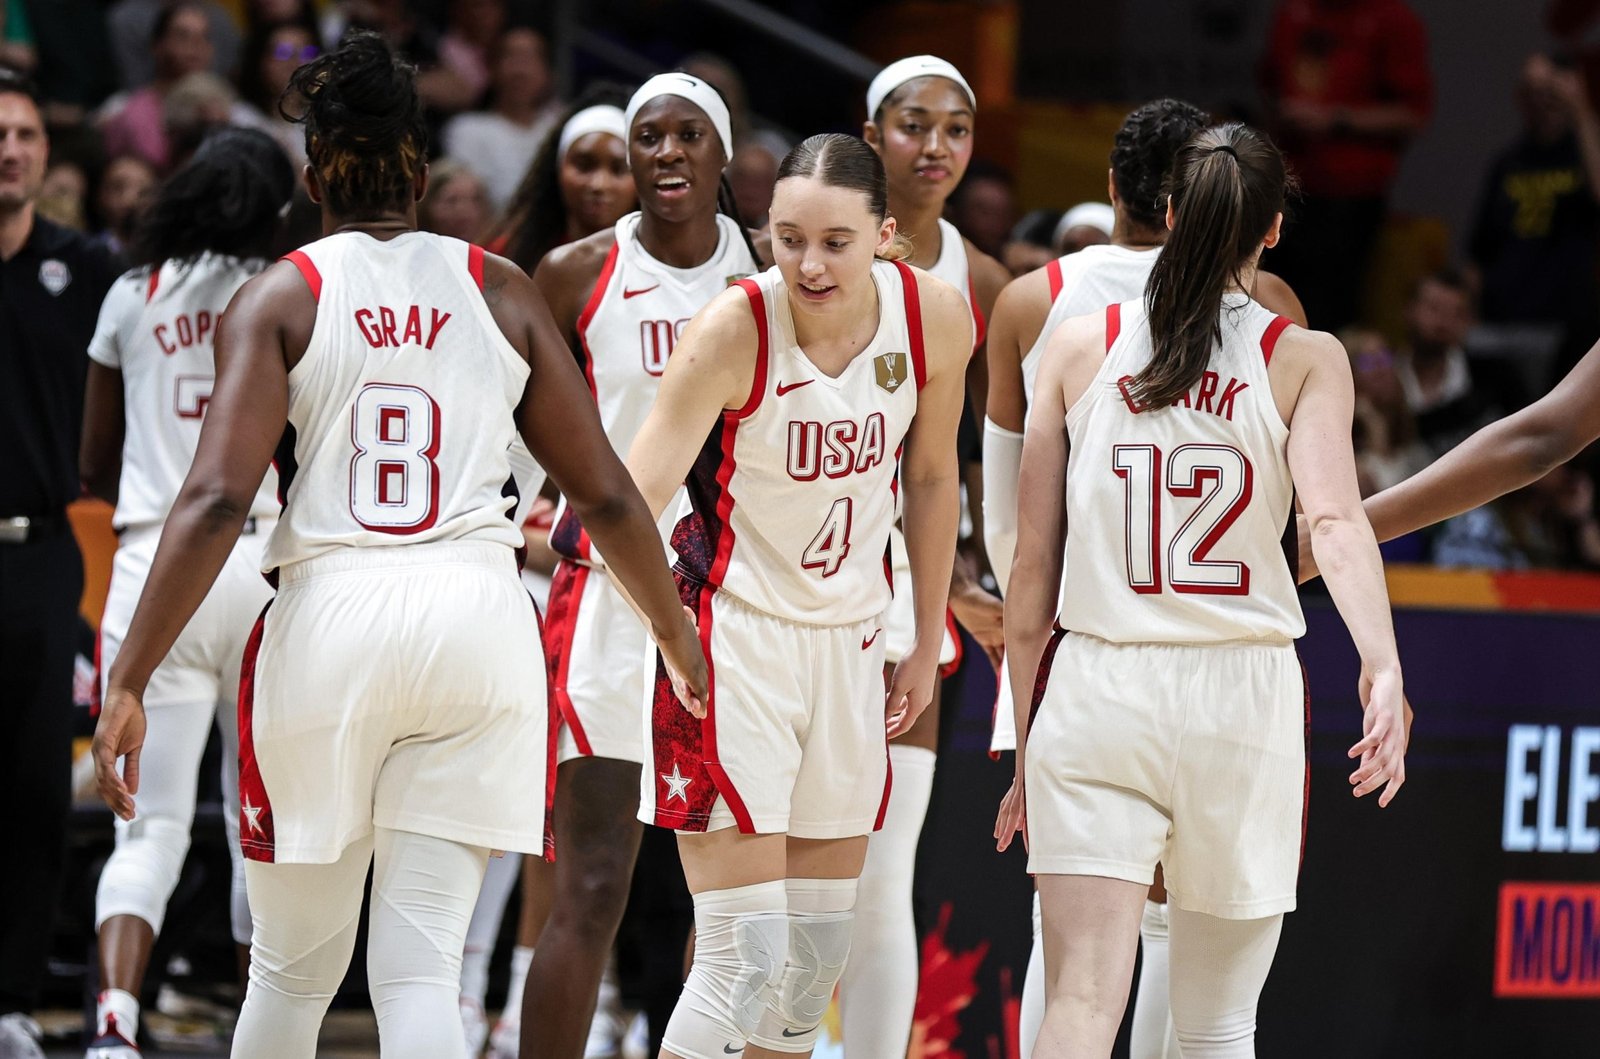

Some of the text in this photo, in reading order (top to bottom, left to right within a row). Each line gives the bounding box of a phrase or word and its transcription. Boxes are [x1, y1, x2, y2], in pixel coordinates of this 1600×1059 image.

[354, 305, 452, 350] GRAY
[349, 382, 441, 535] 8
[786, 411, 886, 482] USA
[801, 496, 853, 578] 4
[1112, 443, 1254, 596] 12
